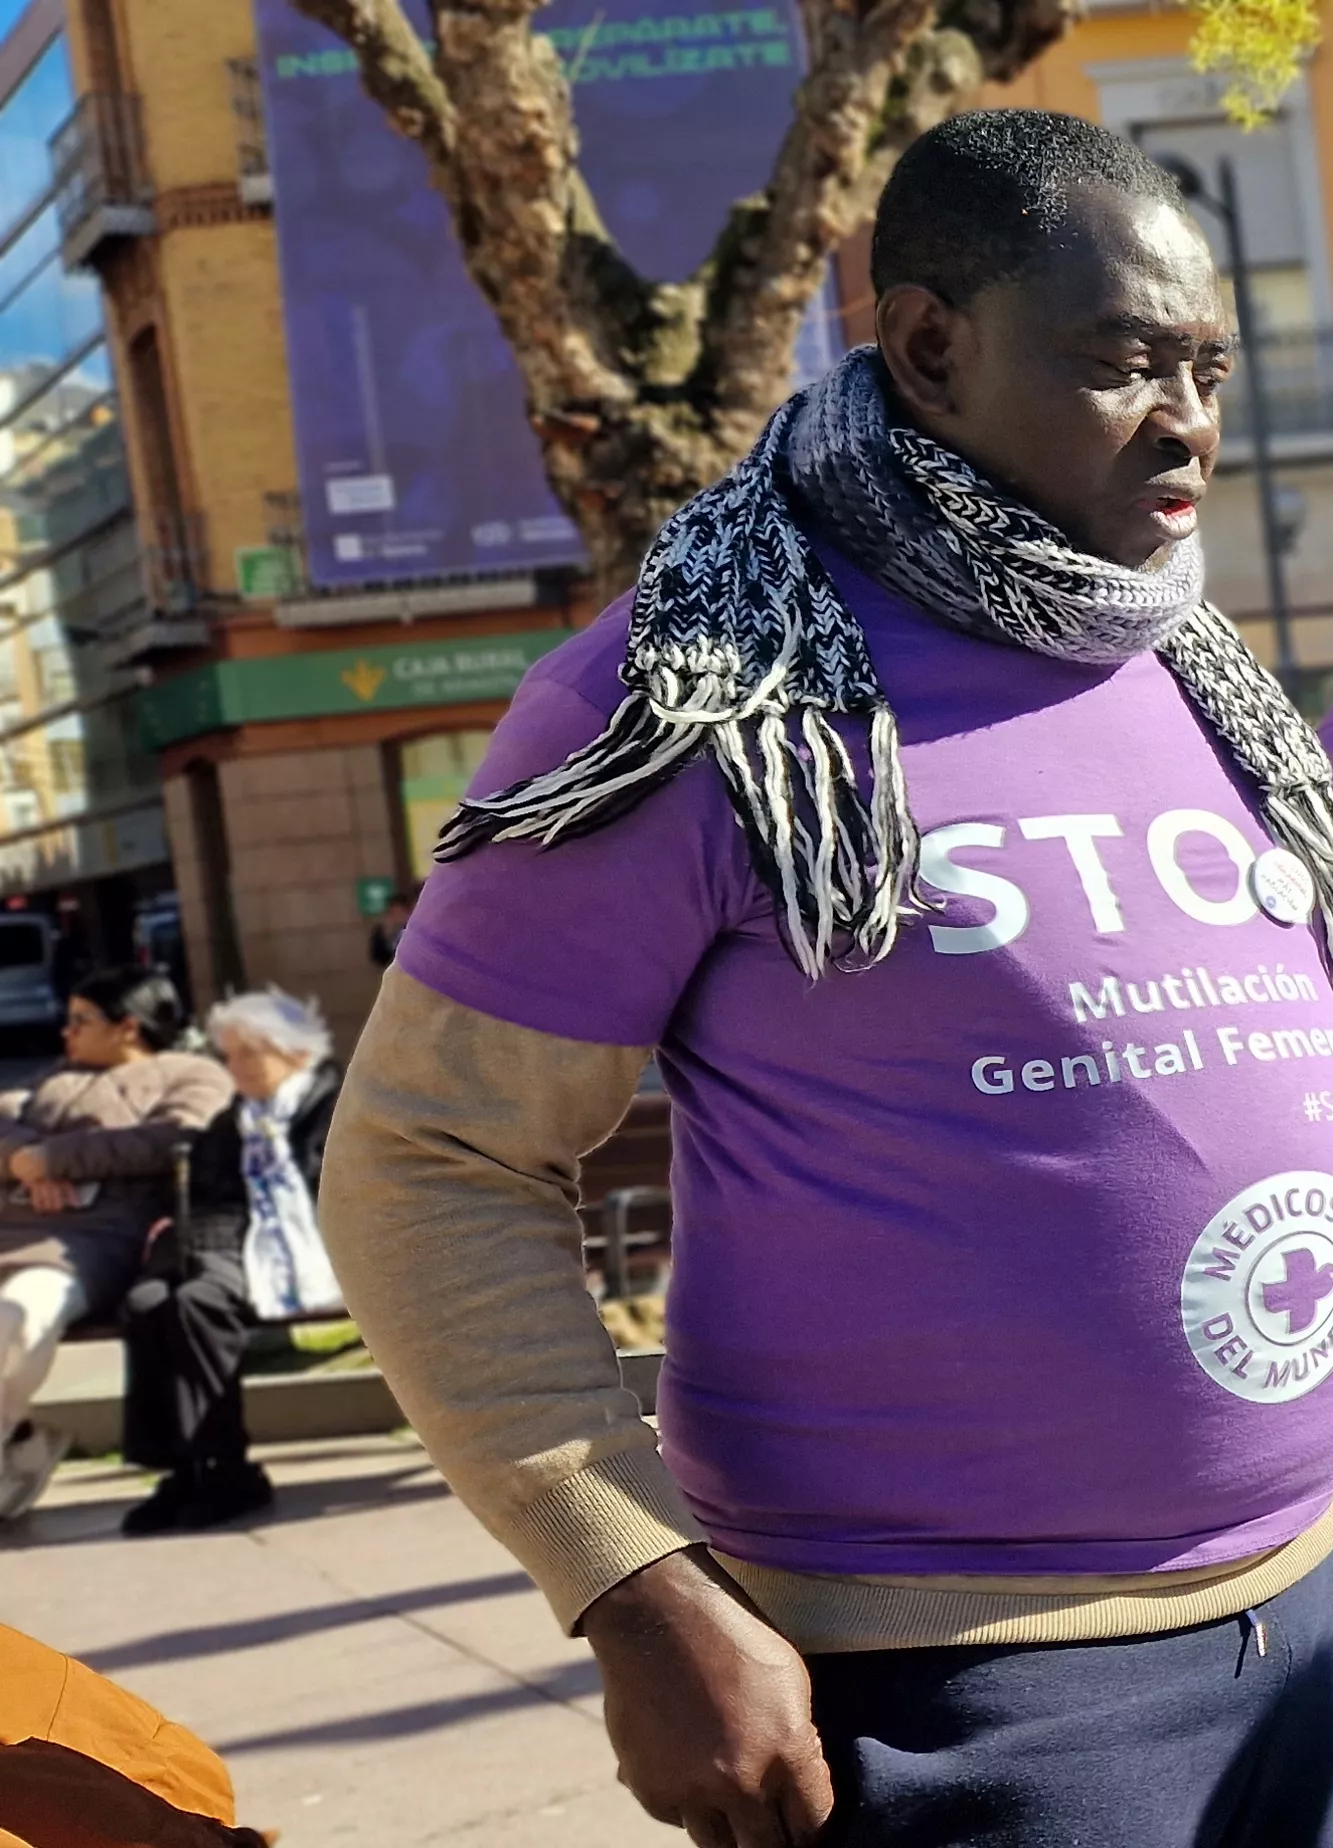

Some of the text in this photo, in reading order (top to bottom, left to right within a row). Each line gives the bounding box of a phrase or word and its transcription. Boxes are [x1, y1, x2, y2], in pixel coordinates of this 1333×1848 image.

[565, 41, 790, 84] OVILÍZATE
[919, 808, 1260, 955] STO
[1069, 963, 1318, 1023] Mutilación
[971, 1030, 1206, 1095] Genital
[1202, 1311, 1256, 1381] DEL
